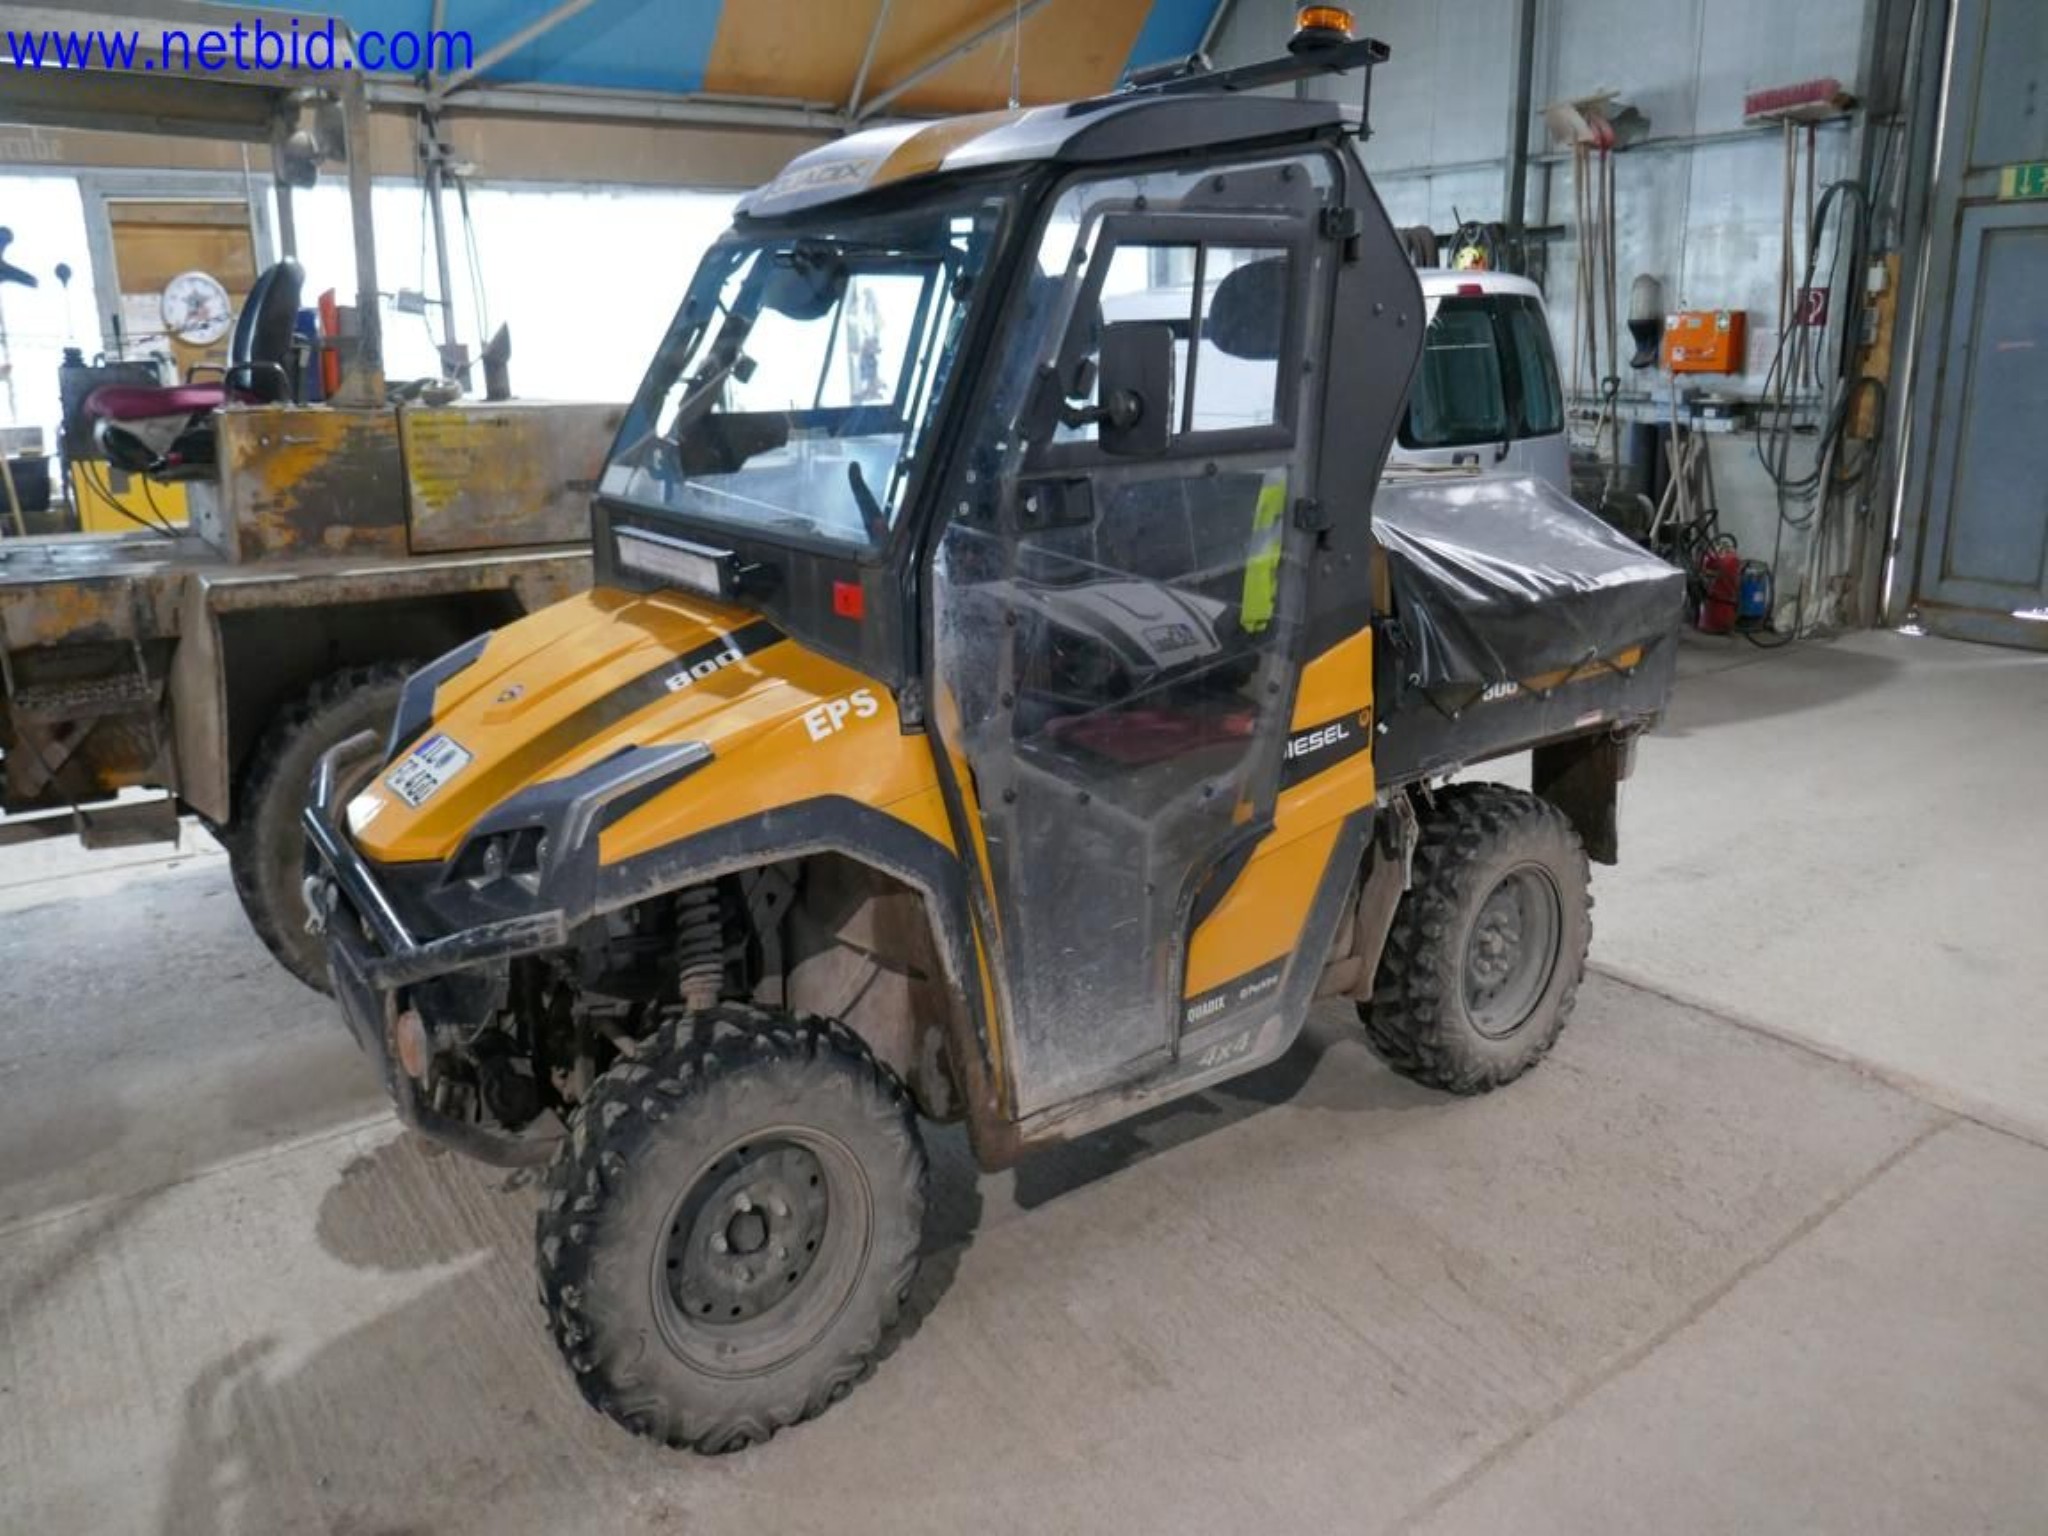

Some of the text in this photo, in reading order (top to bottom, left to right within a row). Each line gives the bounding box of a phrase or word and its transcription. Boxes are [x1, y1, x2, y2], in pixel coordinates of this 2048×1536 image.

[664, 648, 743, 692] 800
[802, 688, 878, 742] EPS
[1283, 722, 1350, 760] IESEL
